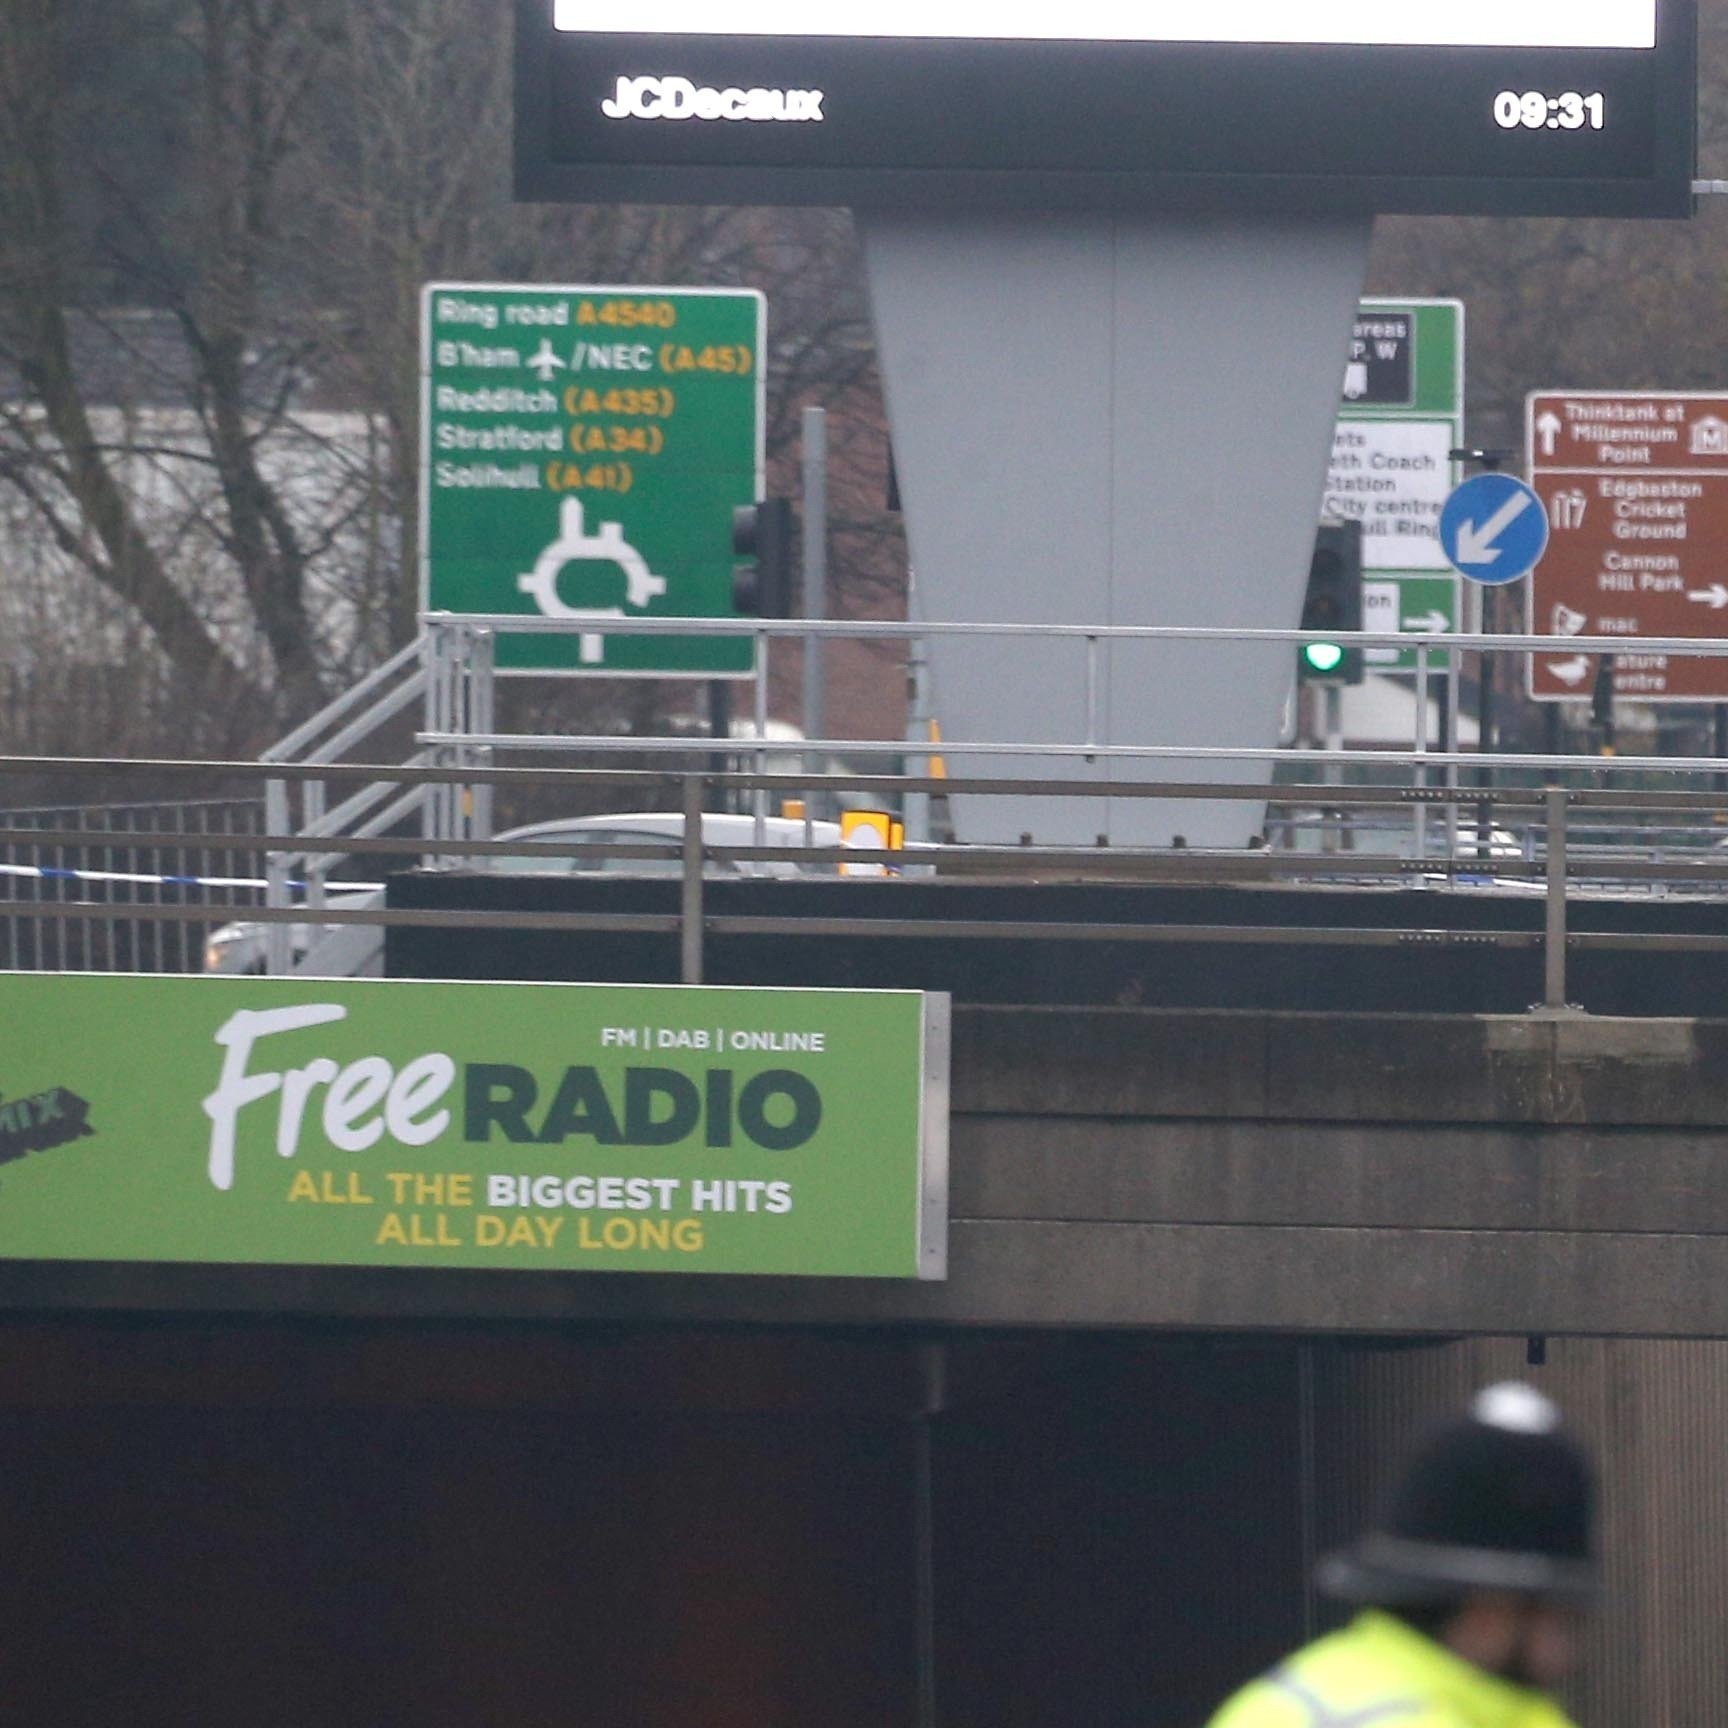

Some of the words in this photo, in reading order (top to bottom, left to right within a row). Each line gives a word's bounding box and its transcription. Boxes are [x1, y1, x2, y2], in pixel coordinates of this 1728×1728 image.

[601, 75, 825, 121] JCDecaux
[1493, 91, 1605, 130] 09:31
[437, 298, 498, 329] Ring
[505, 302, 570, 325] road
[576, 301, 676, 328] A4540
[659, 343, 752, 374] (A45)
[437, 385, 558, 412] Redditch
[563, 386, 676, 418] (A435)
[1565, 403, 1660, 422] Thinktank
[1663, 404, 1685, 422] at
[437, 423, 564, 450] Stratford
[569, 423, 664, 456] (A34)
[1571, 424, 1678, 443] Millennium
[1371, 453, 1437, 471] Coach
[1600, 446, 1651, 463] Point
[436, 461, 541, 489] Solihull
[546, 461, 633, 492] (A41)
[1600, 480, 1703, 501] Edgbaston
[1615, 501, 1687, 519] Cricket
[1614, 522, 1688, 540] Ground
[1604, 551, 1680, 571] Cannon
[1599, 573, 1635, 592] Hill
[1640, 575, 1684, 592] Park
[1615, 655, 1668, 670] ature
[1615, 673, 1667, 691] entre
[601, 1027, 640, 1049] FM
[657, 1028, 712, 1051] DAB
[730, 1030, 826, 1054] ONLINE
[202, 1003, 456, 1191] Free
[464, 1063, 823, 1151] RADIO
[288, 1172, 374, 1204] ALL
[387, 1173, 473, 1206] THE
[487, 1174, 681, 1212] BIGGEST
[691, 1179, 794, 1214] HITS
[376, 1214, 461, 1247] ALL
[475, 1216, 564, 1247] DAY
[578, 1218, 704, 1252] LONG
